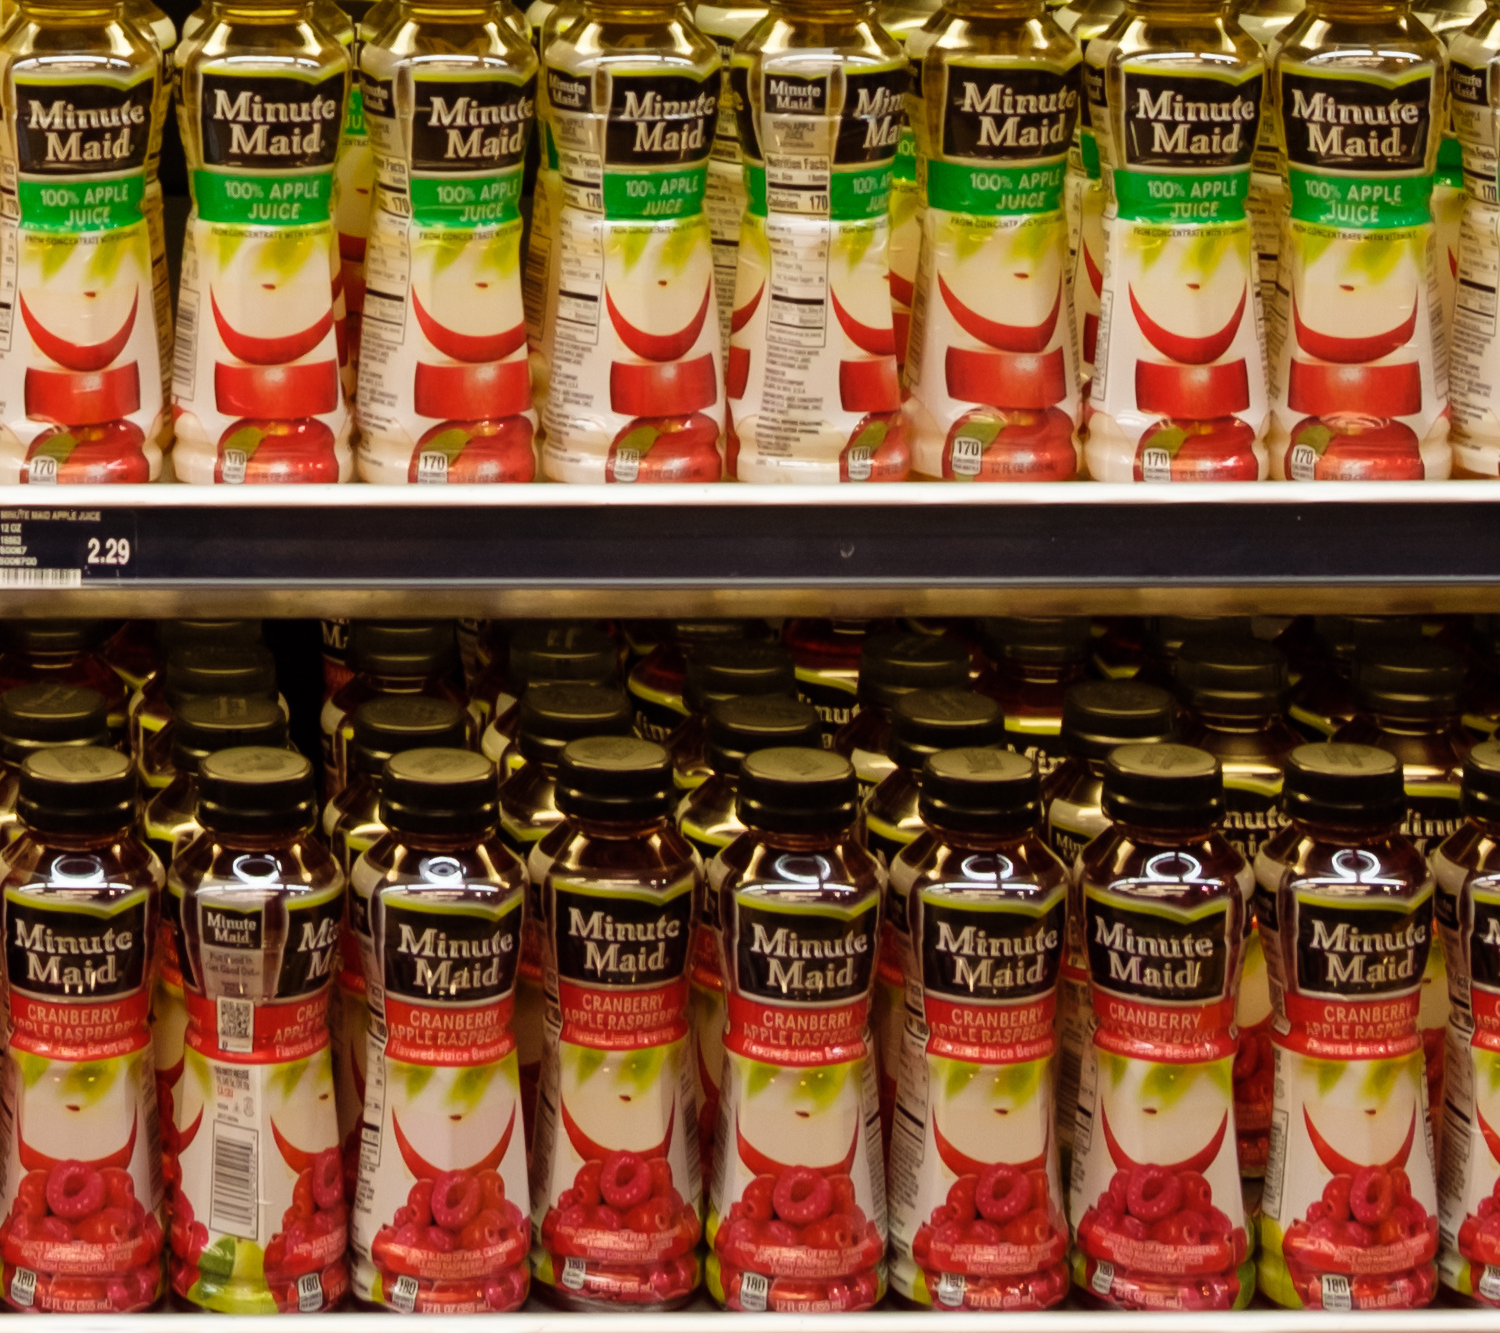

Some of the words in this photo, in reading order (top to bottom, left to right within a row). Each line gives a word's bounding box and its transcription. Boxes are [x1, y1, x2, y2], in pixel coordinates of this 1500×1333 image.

[213, 87, 336, 125] Minute
[229, 121, 326, 158] Maid
[224, 180, 262, 200] 100%
[268, 180, 320, 200] APPLE
[248, 202, 301, 220] JUICE
[87, 538, 130, 564] 2.29
[568, 906, 680, 944] Minute
[584, 990, 666, 1015] CRANBERRY
